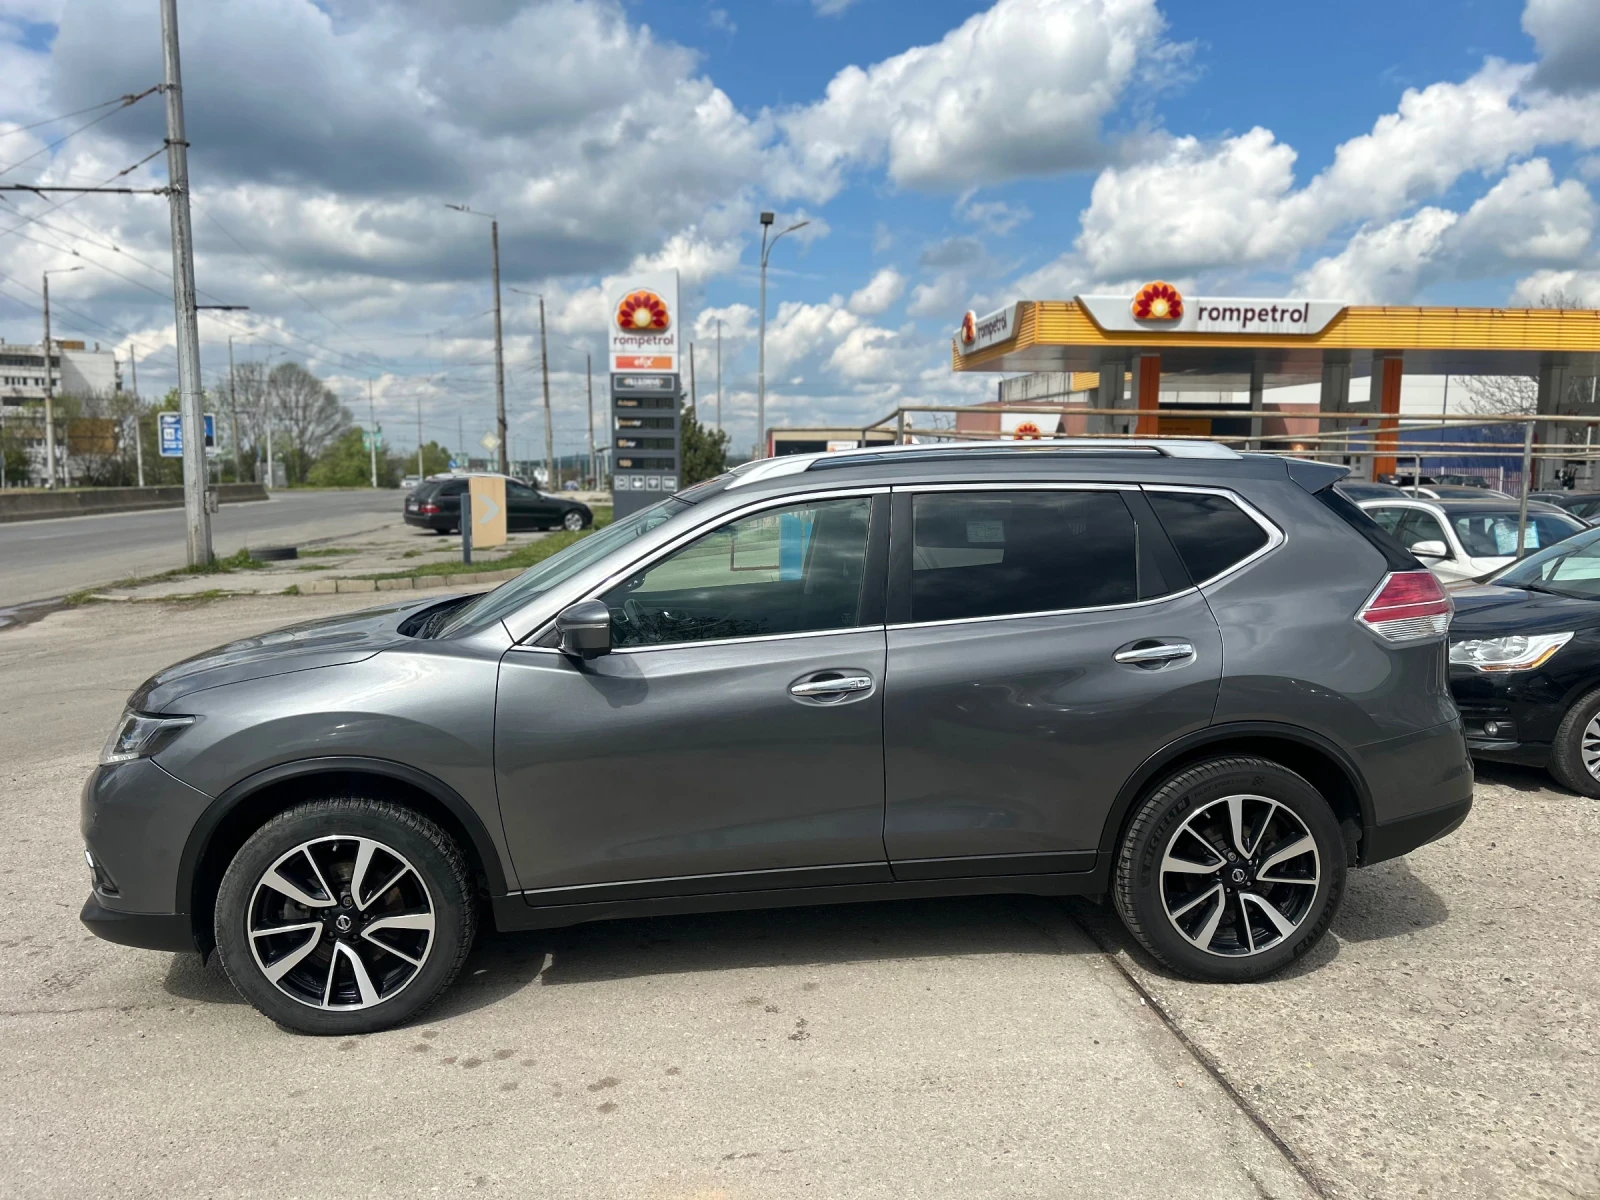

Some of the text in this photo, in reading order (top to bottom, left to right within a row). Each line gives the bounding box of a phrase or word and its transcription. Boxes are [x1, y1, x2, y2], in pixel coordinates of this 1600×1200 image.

[1198, 302, 1309, 328] rompetrol
[613, 334, 674, 348] rompetrol
[1143, 799, 1188, 869] MICHELIN
